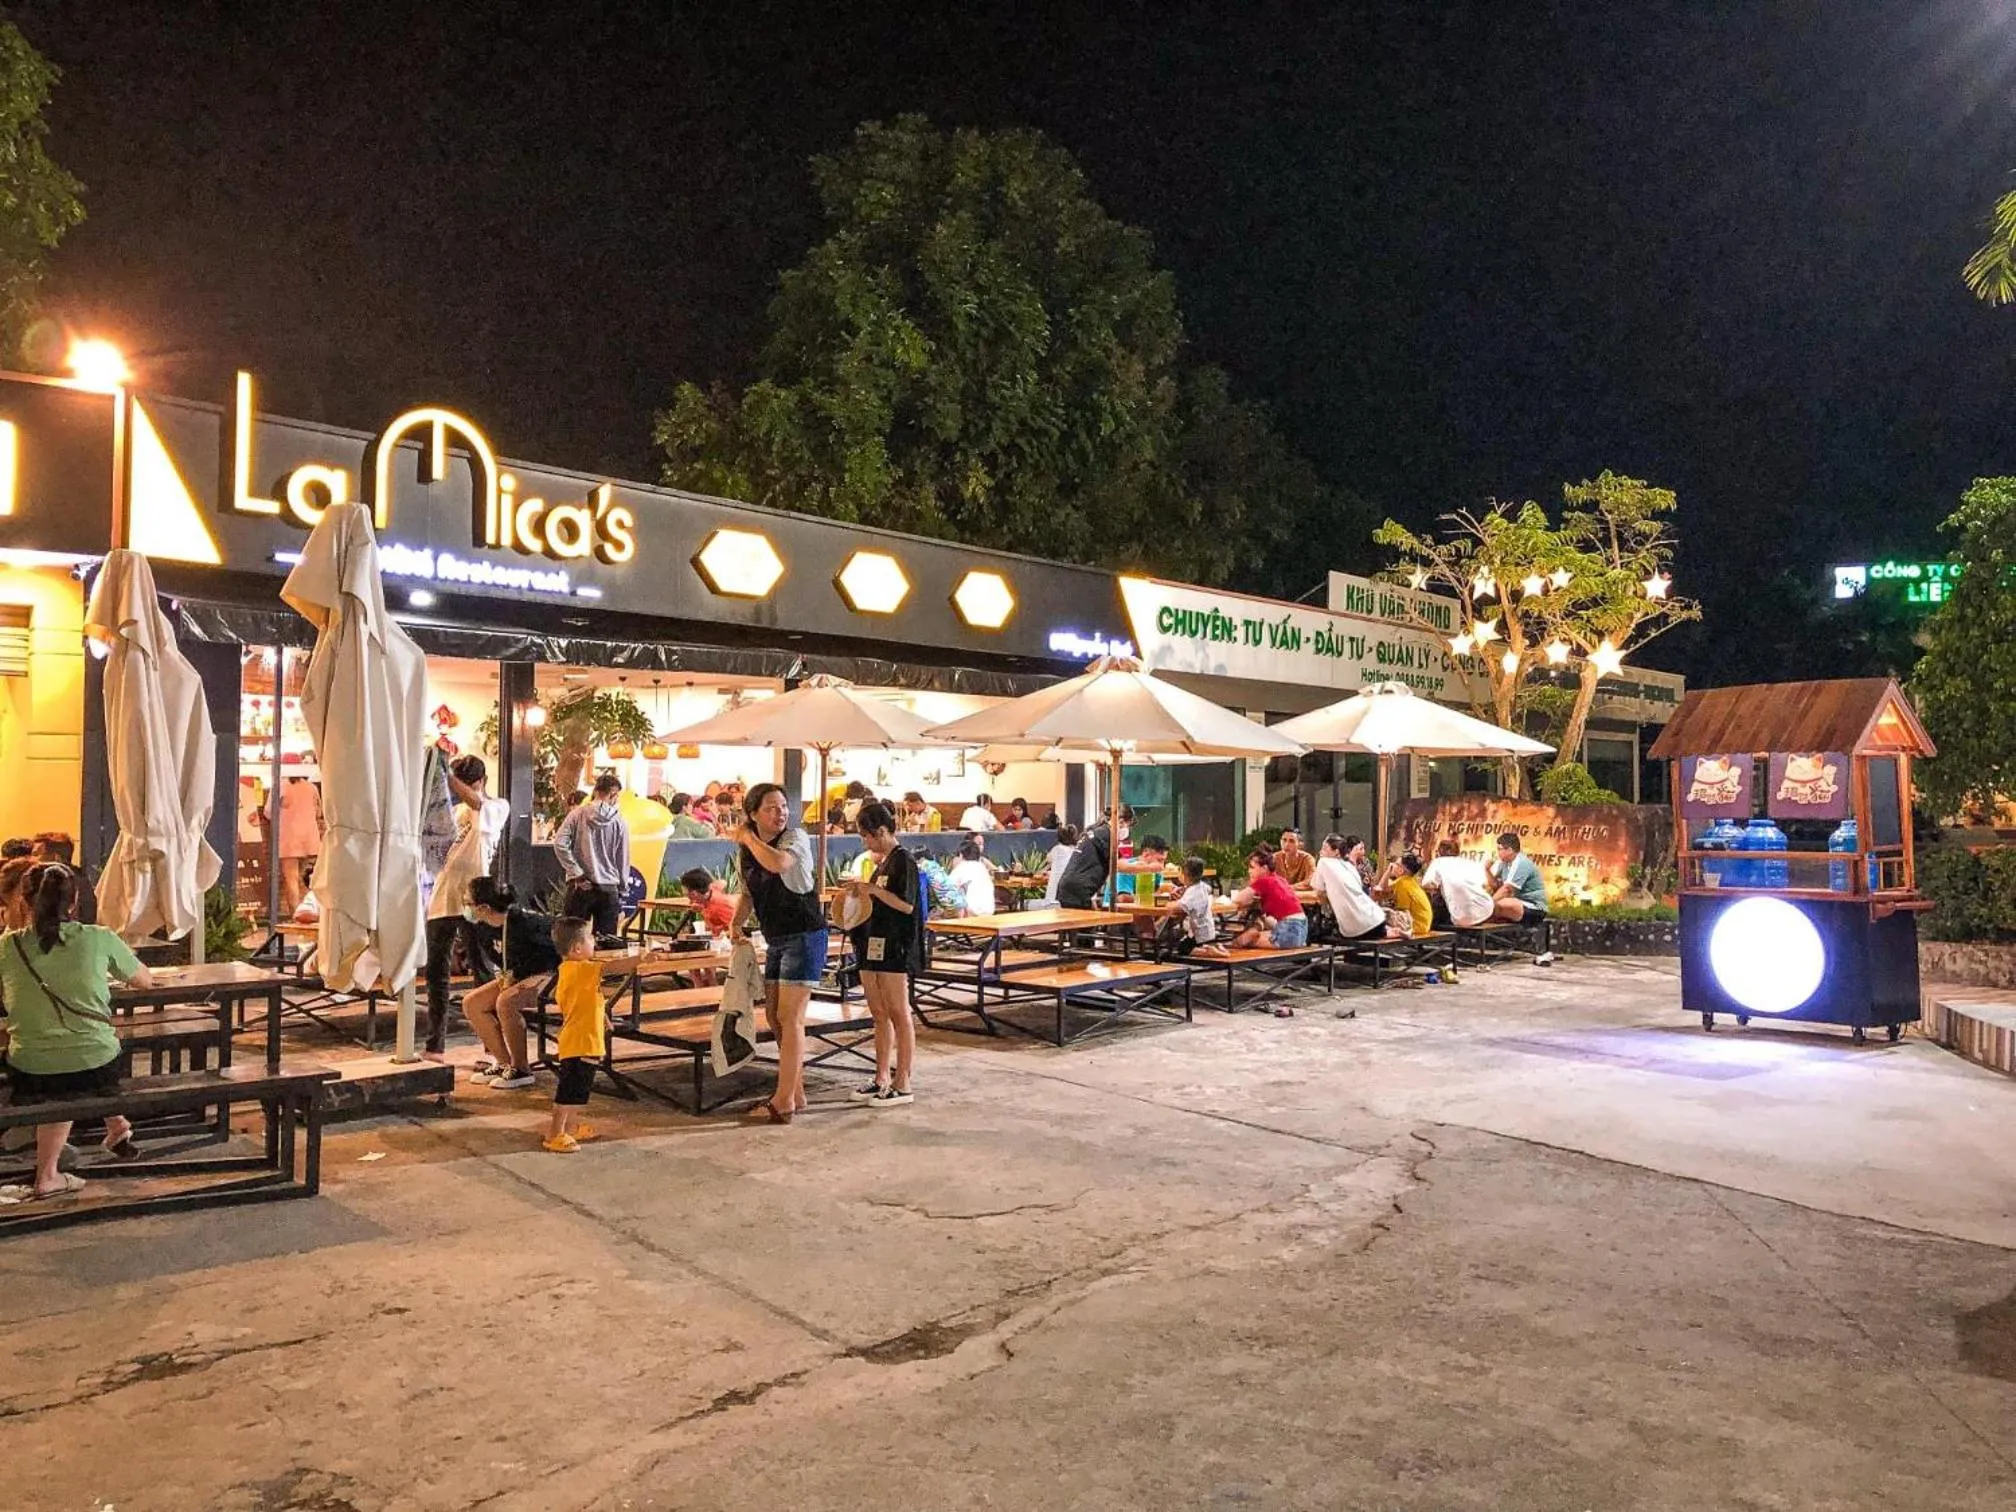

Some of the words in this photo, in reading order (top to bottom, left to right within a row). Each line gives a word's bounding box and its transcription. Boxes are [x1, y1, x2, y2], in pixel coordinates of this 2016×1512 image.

[234, 370, 348, 525] La
[376, 408, 635, 563] Mica's
[1870, 561, 1921, 578] CÔNG
[1926, 565, 1945, 577] TY
[1157, 606, 1238, 644] CHUYÊN:
[1242, 618, 1264, 647] TƯ
[1268, 613, 1302, 652] VẤN
[1347, 634, 1366, 660] TƯ
[1412, 818, 1442, 833] KHU
